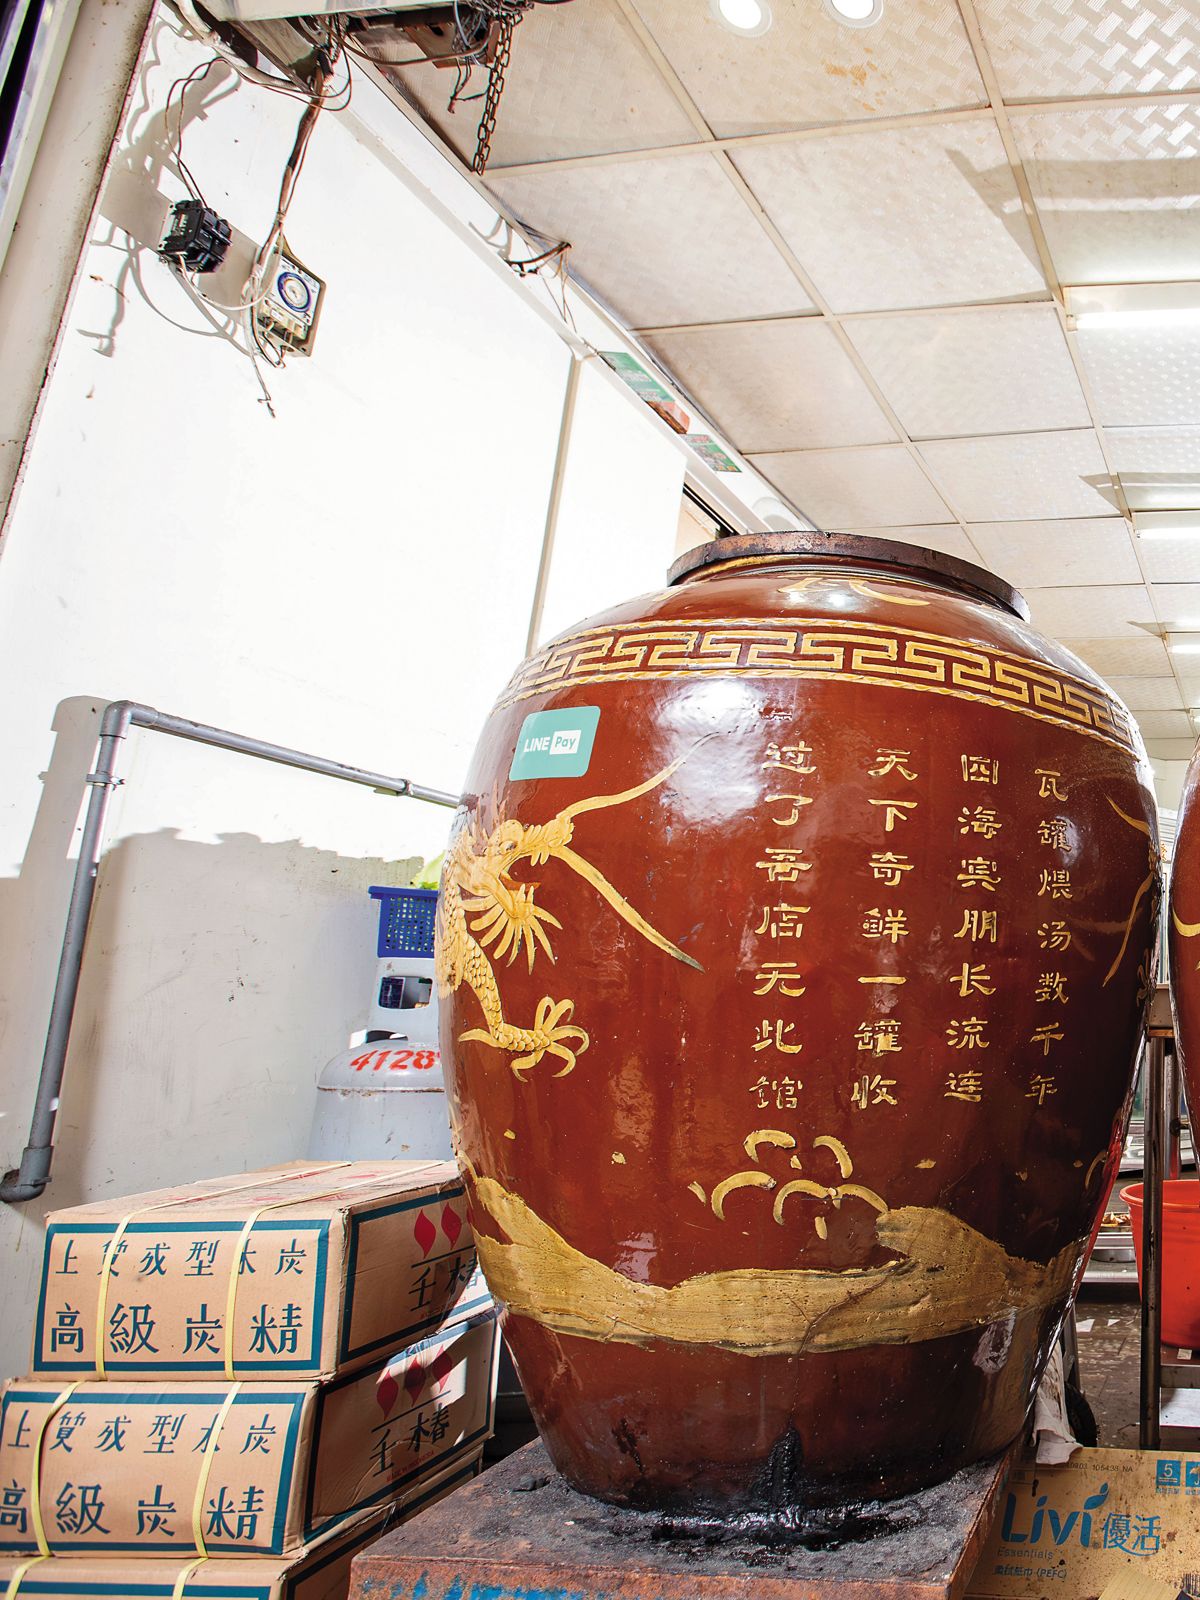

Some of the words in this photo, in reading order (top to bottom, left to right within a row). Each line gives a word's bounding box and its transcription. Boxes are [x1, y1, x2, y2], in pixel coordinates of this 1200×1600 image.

[523, 736, 551, 753] LINE
[554, 736, 577, 750] Pay
[350, 1049, 441, 1072] 4128
[50, 1301, 304, 1355] 高級炭精
[1163, 1463, 1174, 1478] 5
[0, 1478, 265, 1541] 高級炭精
[1002, 1482, 1110, 1548] Livi
[1102, 1512, 1161, 1552] 優活
